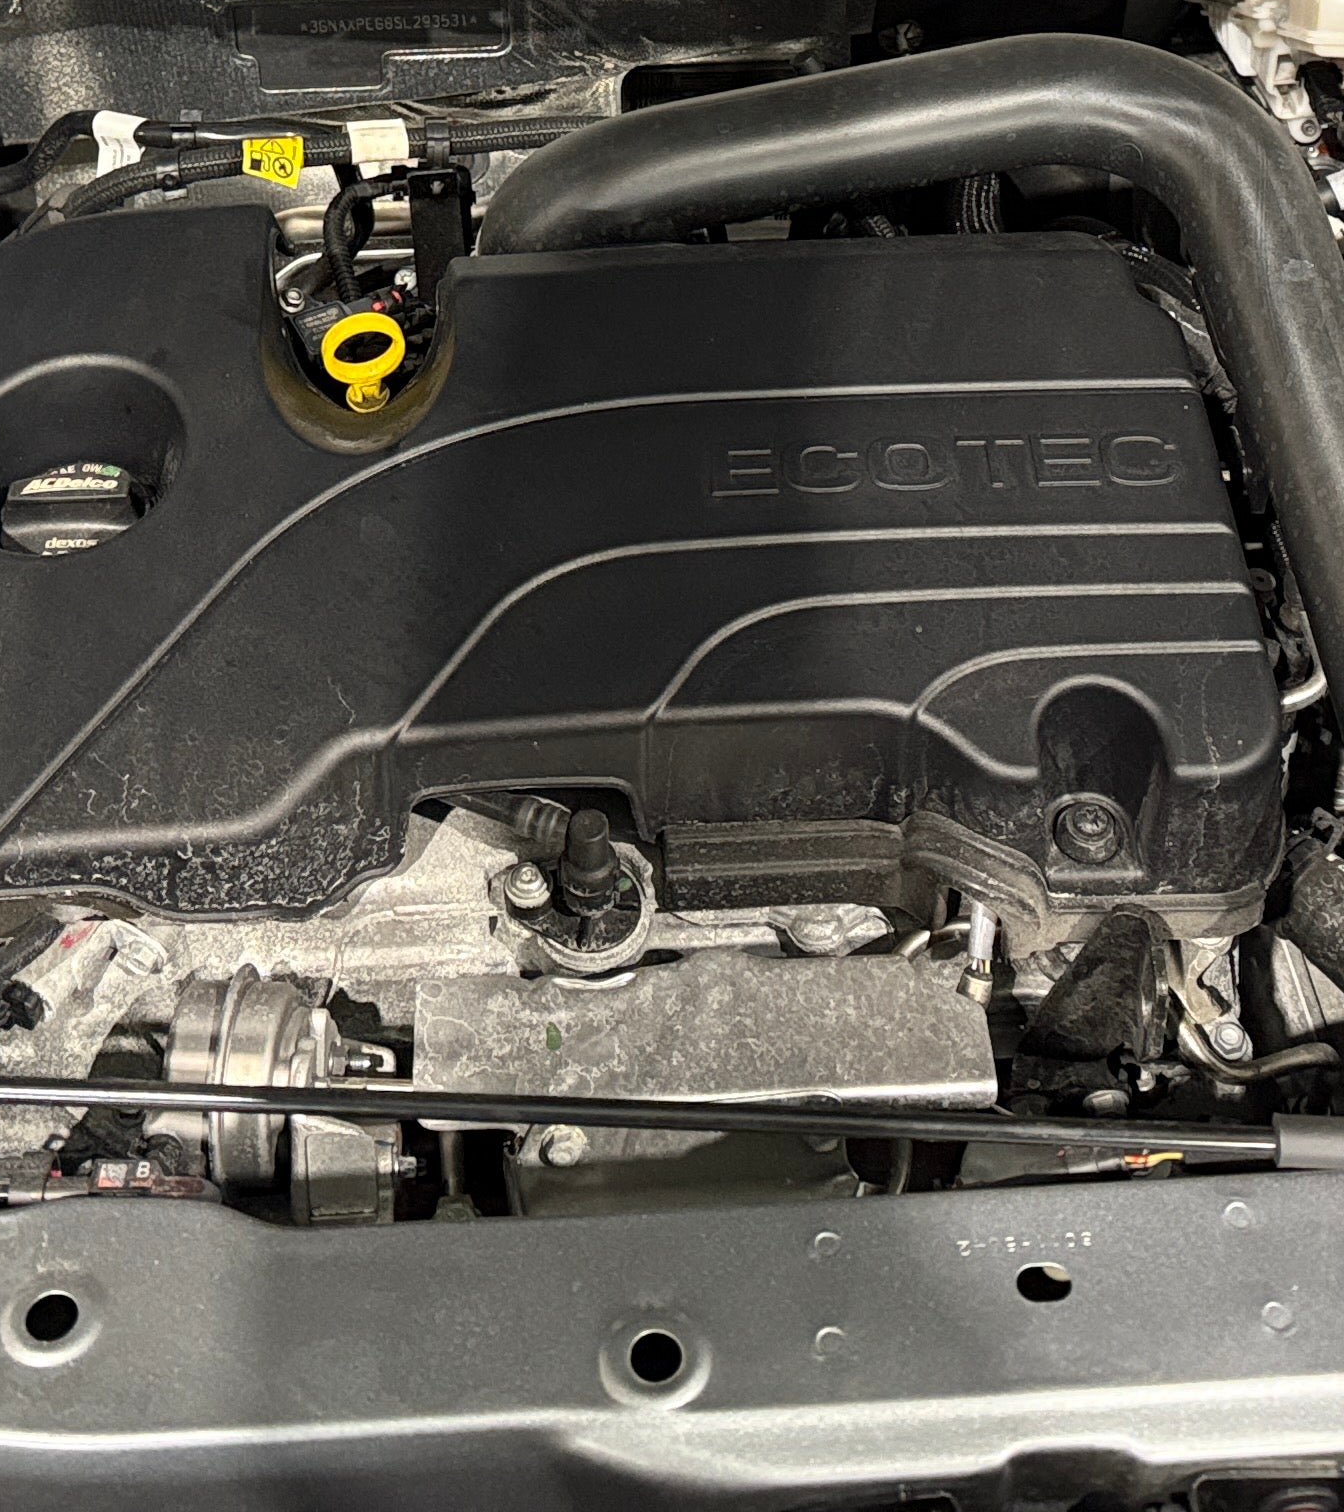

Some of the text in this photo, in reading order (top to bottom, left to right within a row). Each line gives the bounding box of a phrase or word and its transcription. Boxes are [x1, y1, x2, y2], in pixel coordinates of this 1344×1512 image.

[710, 434, 1177, 498] ECOTEC
[21, 476, 119, 494] ACDelco
[44, 536, 100, 549] dexos
